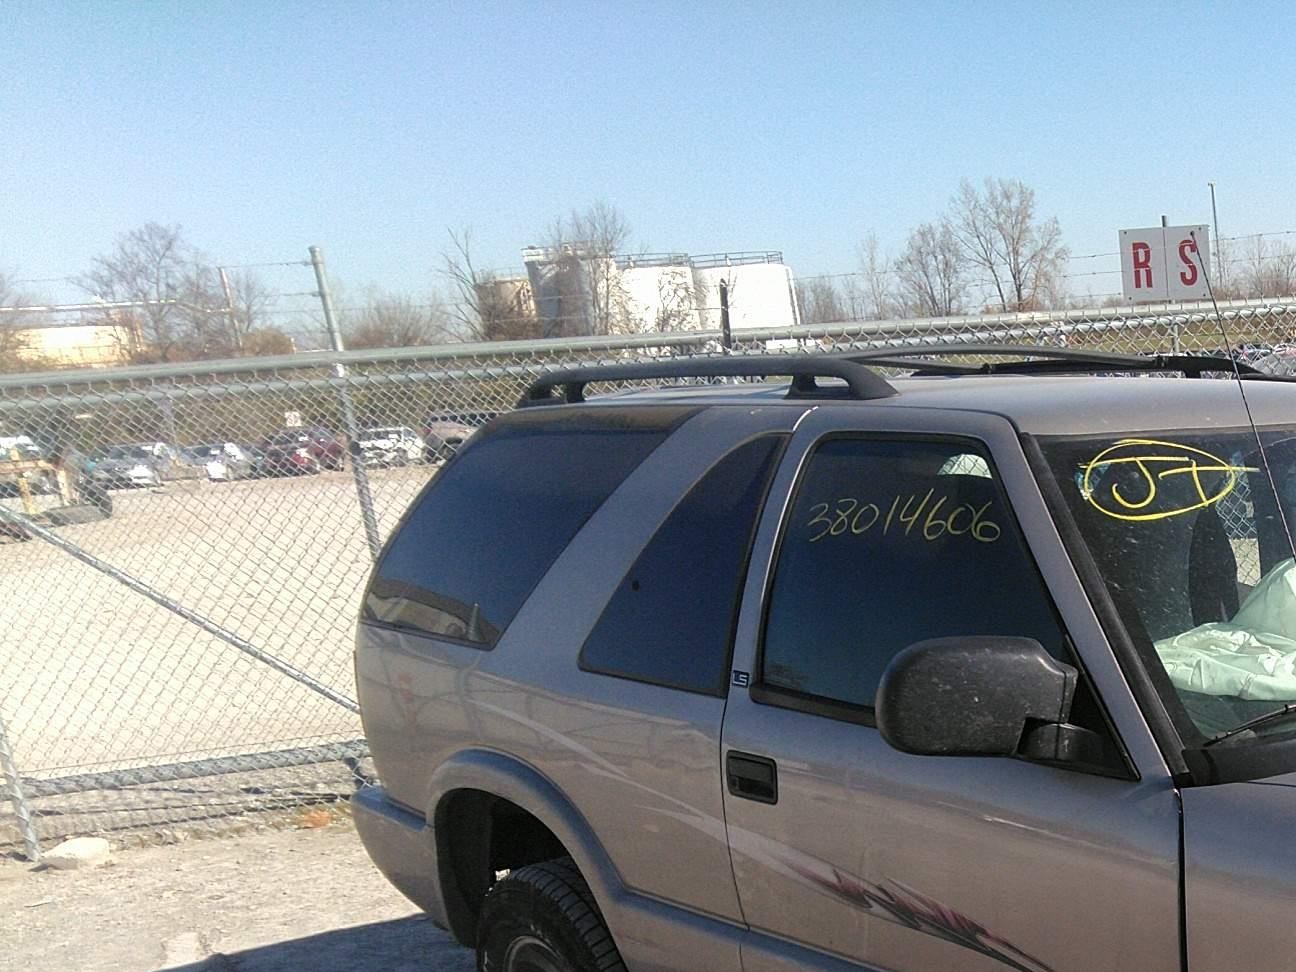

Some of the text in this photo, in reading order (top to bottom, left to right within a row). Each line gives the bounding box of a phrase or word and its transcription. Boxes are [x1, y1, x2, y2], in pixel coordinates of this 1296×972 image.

[1132, 239, 1199, 289] R S
[807, 488, 1000, 542] 38014606
[732, 671, 748, 687] LS
